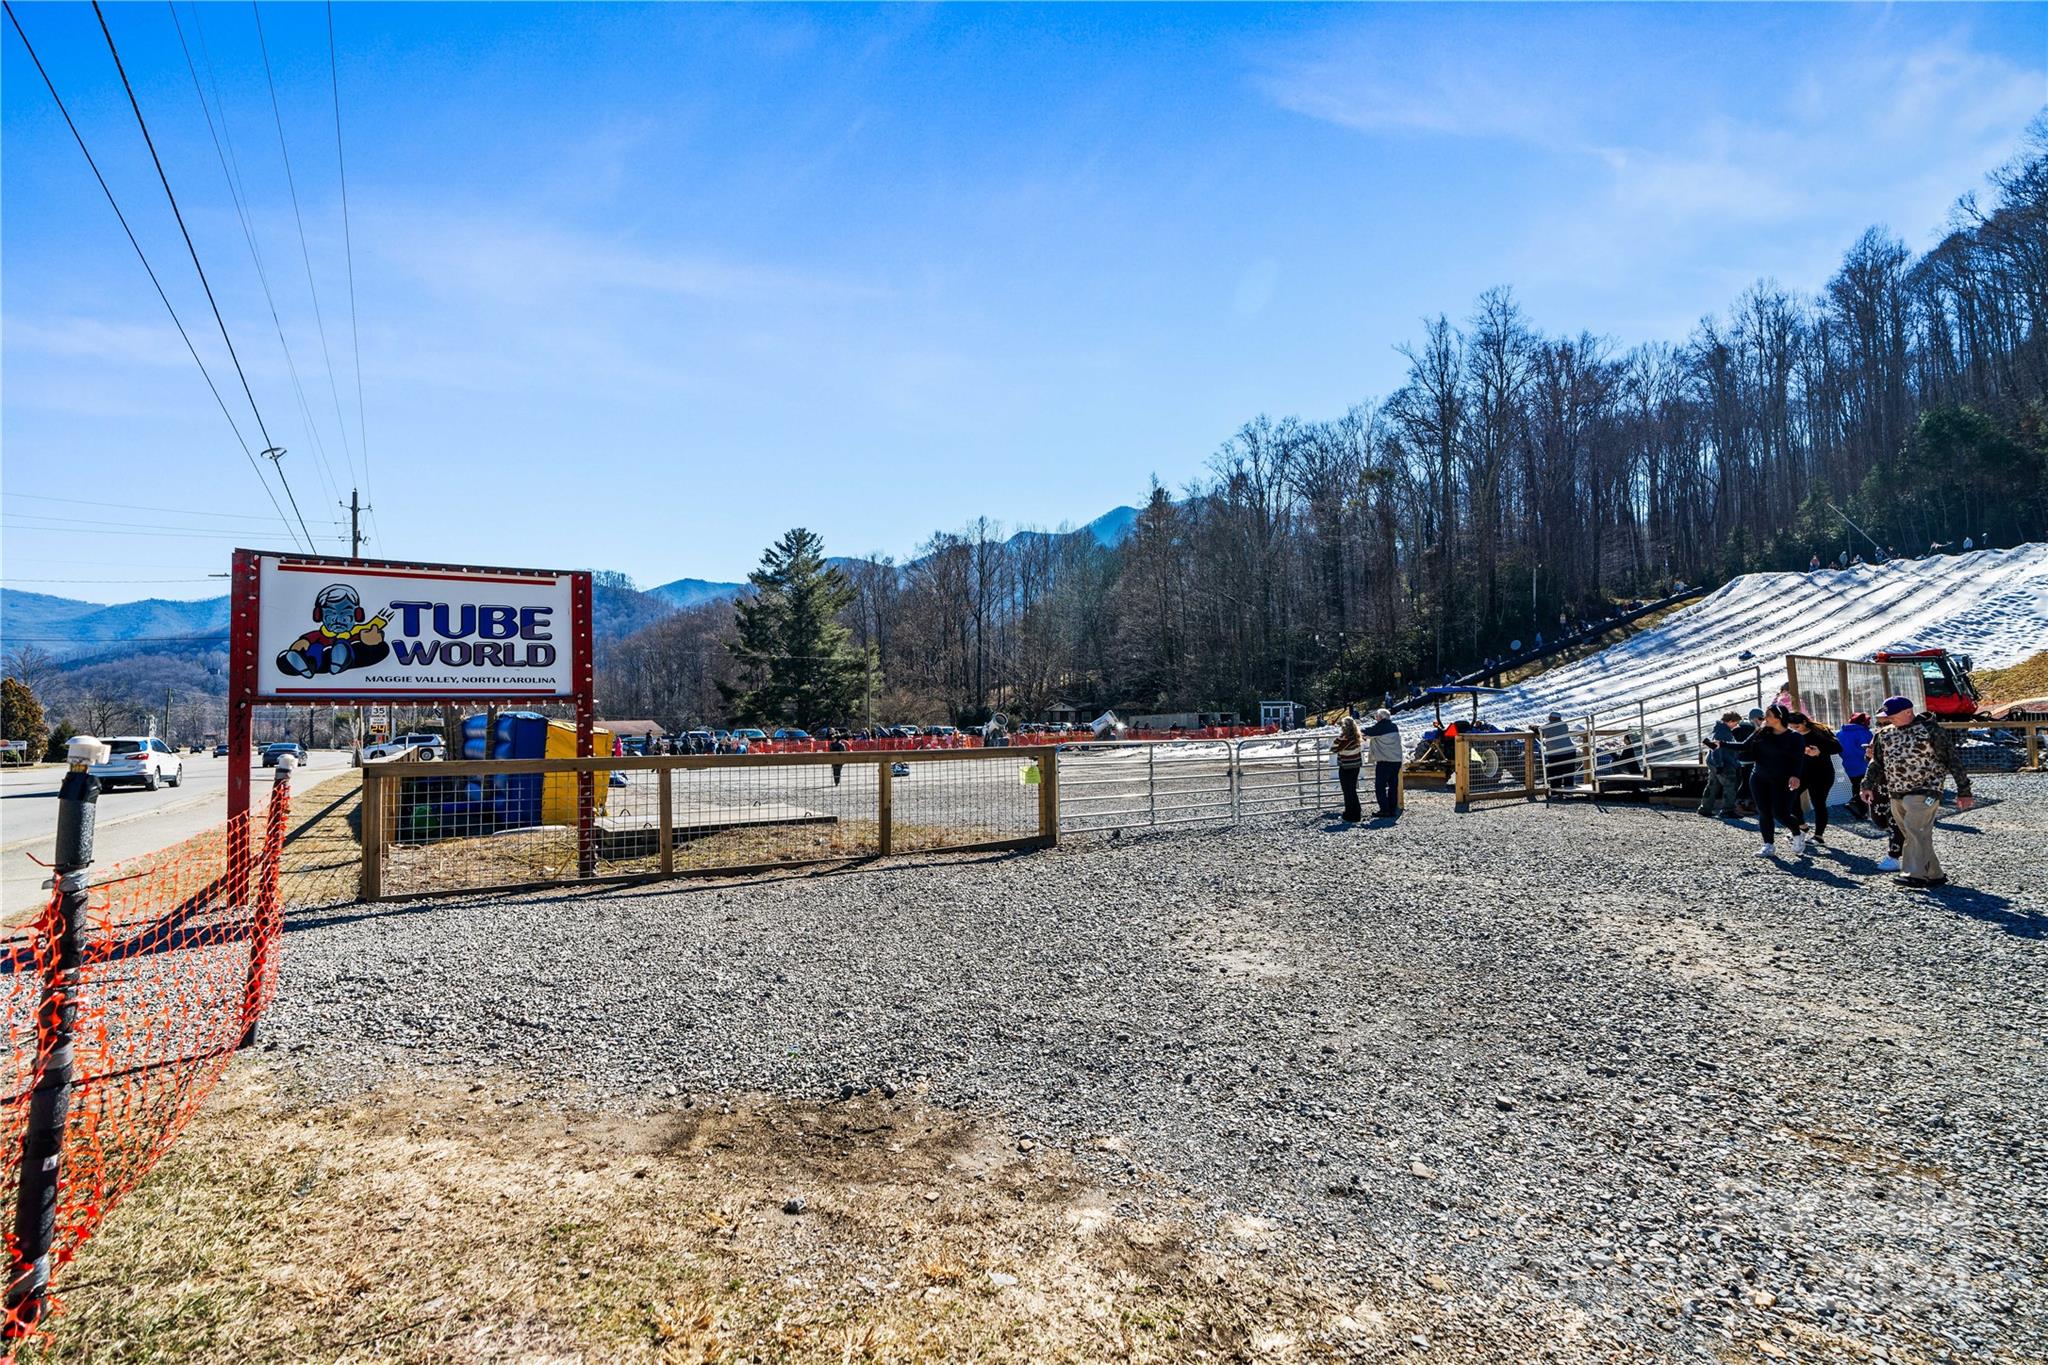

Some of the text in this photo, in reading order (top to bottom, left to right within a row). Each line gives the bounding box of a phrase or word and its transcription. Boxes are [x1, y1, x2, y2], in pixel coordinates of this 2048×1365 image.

[389, 600, 553, 640] TUBE
[391, 639, 555, 667] WORLD
[365, 675, 556, 684] MAGGIE VALLEY, NORTH CAROLINA
